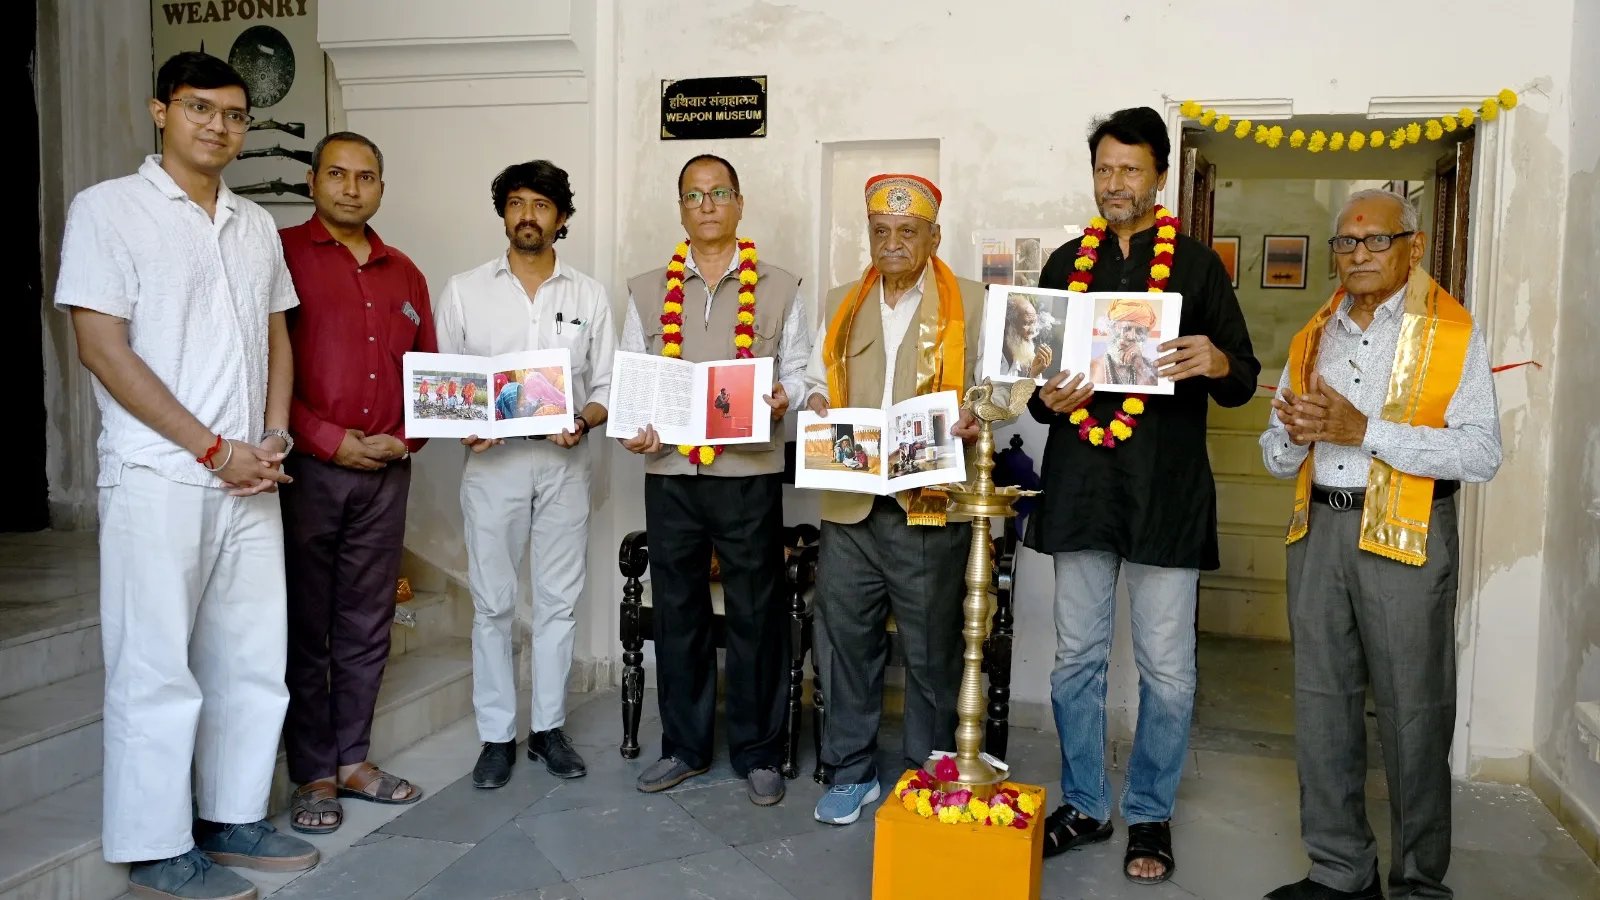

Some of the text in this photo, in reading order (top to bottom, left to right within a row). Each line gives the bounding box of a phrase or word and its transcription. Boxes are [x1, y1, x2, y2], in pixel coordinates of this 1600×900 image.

[162, 0, 307, 25] WEAPONRY
[668, 92, 758, 109] हथियार संग्रहालय
[666, 110, 761, 122] WEAPON MUSEUM
